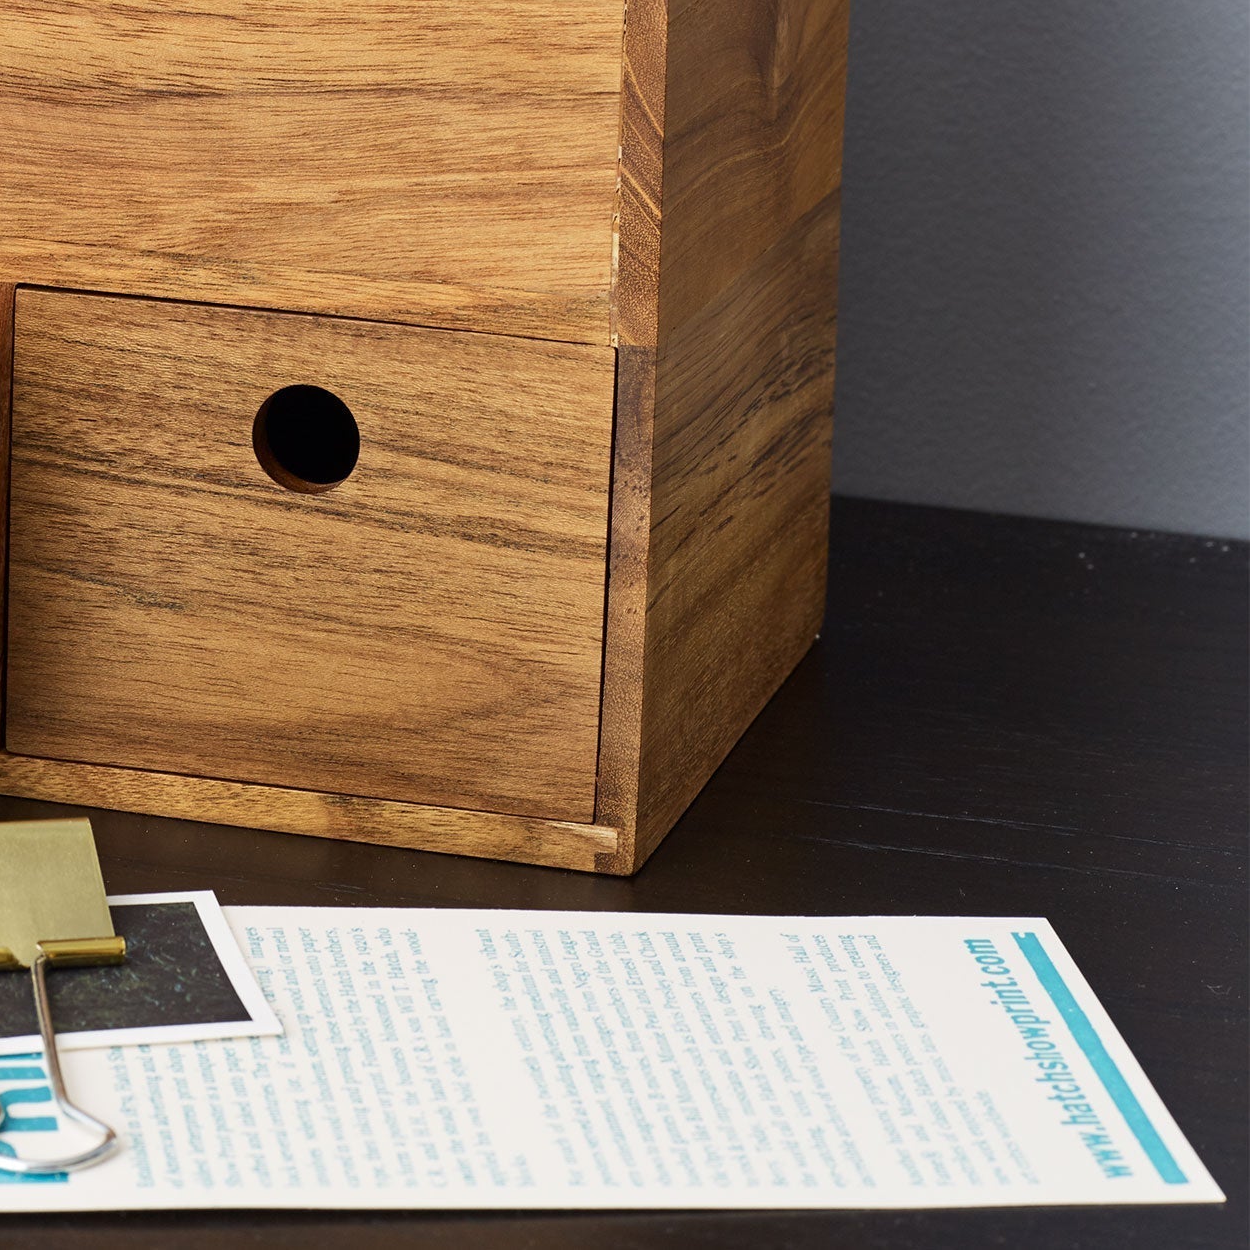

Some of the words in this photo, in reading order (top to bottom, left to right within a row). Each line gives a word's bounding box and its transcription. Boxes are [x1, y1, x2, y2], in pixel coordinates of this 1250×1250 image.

[238, 925, 268, 958] images
[265, 925, 290, 952] metal
[295, 926, 321, 953] paper
[318, 926, 350, 968] brothers,
[345, 926, 373, 955] 1920's
[371, 926, 394, 945] who
[397, 926, 424, 954] wood-
[470, 927, 499, 959] vibrant
[497, 929, 525, 958] South-
[523, 928, 555, 965] minstrel
[550, 928, 584, 960] League
[576, 929, 605, 957] Grand
[602, 929, 631, 954] Tubb,
[629, 930, 658, 958] Chuck
[655, 930, 686, 962] around
[681, 930, 712, 952] print
[707, 931, 740, 958] shop's
[780, 932, 800, 942] of
[857, 933, 882, 950] and
[786, 945, 811, 963] Hall
[806, 933, 846, 972] produces
[832, 933, 870, 968] creating
[274, 954, 302, 985] and/or
[300, 954, 324, 976] onto
[356, 960, 378, 975] the
[378, 948, 407, 979] Hatch,
[408, 959, 430, 973] the
[509, 960, 531, 972] for
[539, 968, 562, 984] and
[564, 961, 595, 988] Negro
[589, 959, 612, 973] the
[614, 957, 643, 985] Ernest
[642, 959, 666, 976] and
[693, 956, 717, 972] and
[724, 965, 747, 979] the
[851, 970, 872, 979] to
[868, 952, 909, 992] designers
[331, 969, 357, 996] Hatch
[362, 980, 382, 989] in
[484, 964, 515, 991] shop's
[596, 976, 616, 984] of
[671, 966, 698, 987] from
[797, 967, 826, 992] Music
[496, 995, 518, 1010] the
[627, 987, 651, 1004] and
[737, 985, 755, 997] on
[341, 998, 363, 1013] the
[717, 1007, 738, 1016] to
[963, 939, 1134, 1179] www.hatchshowprint.com
